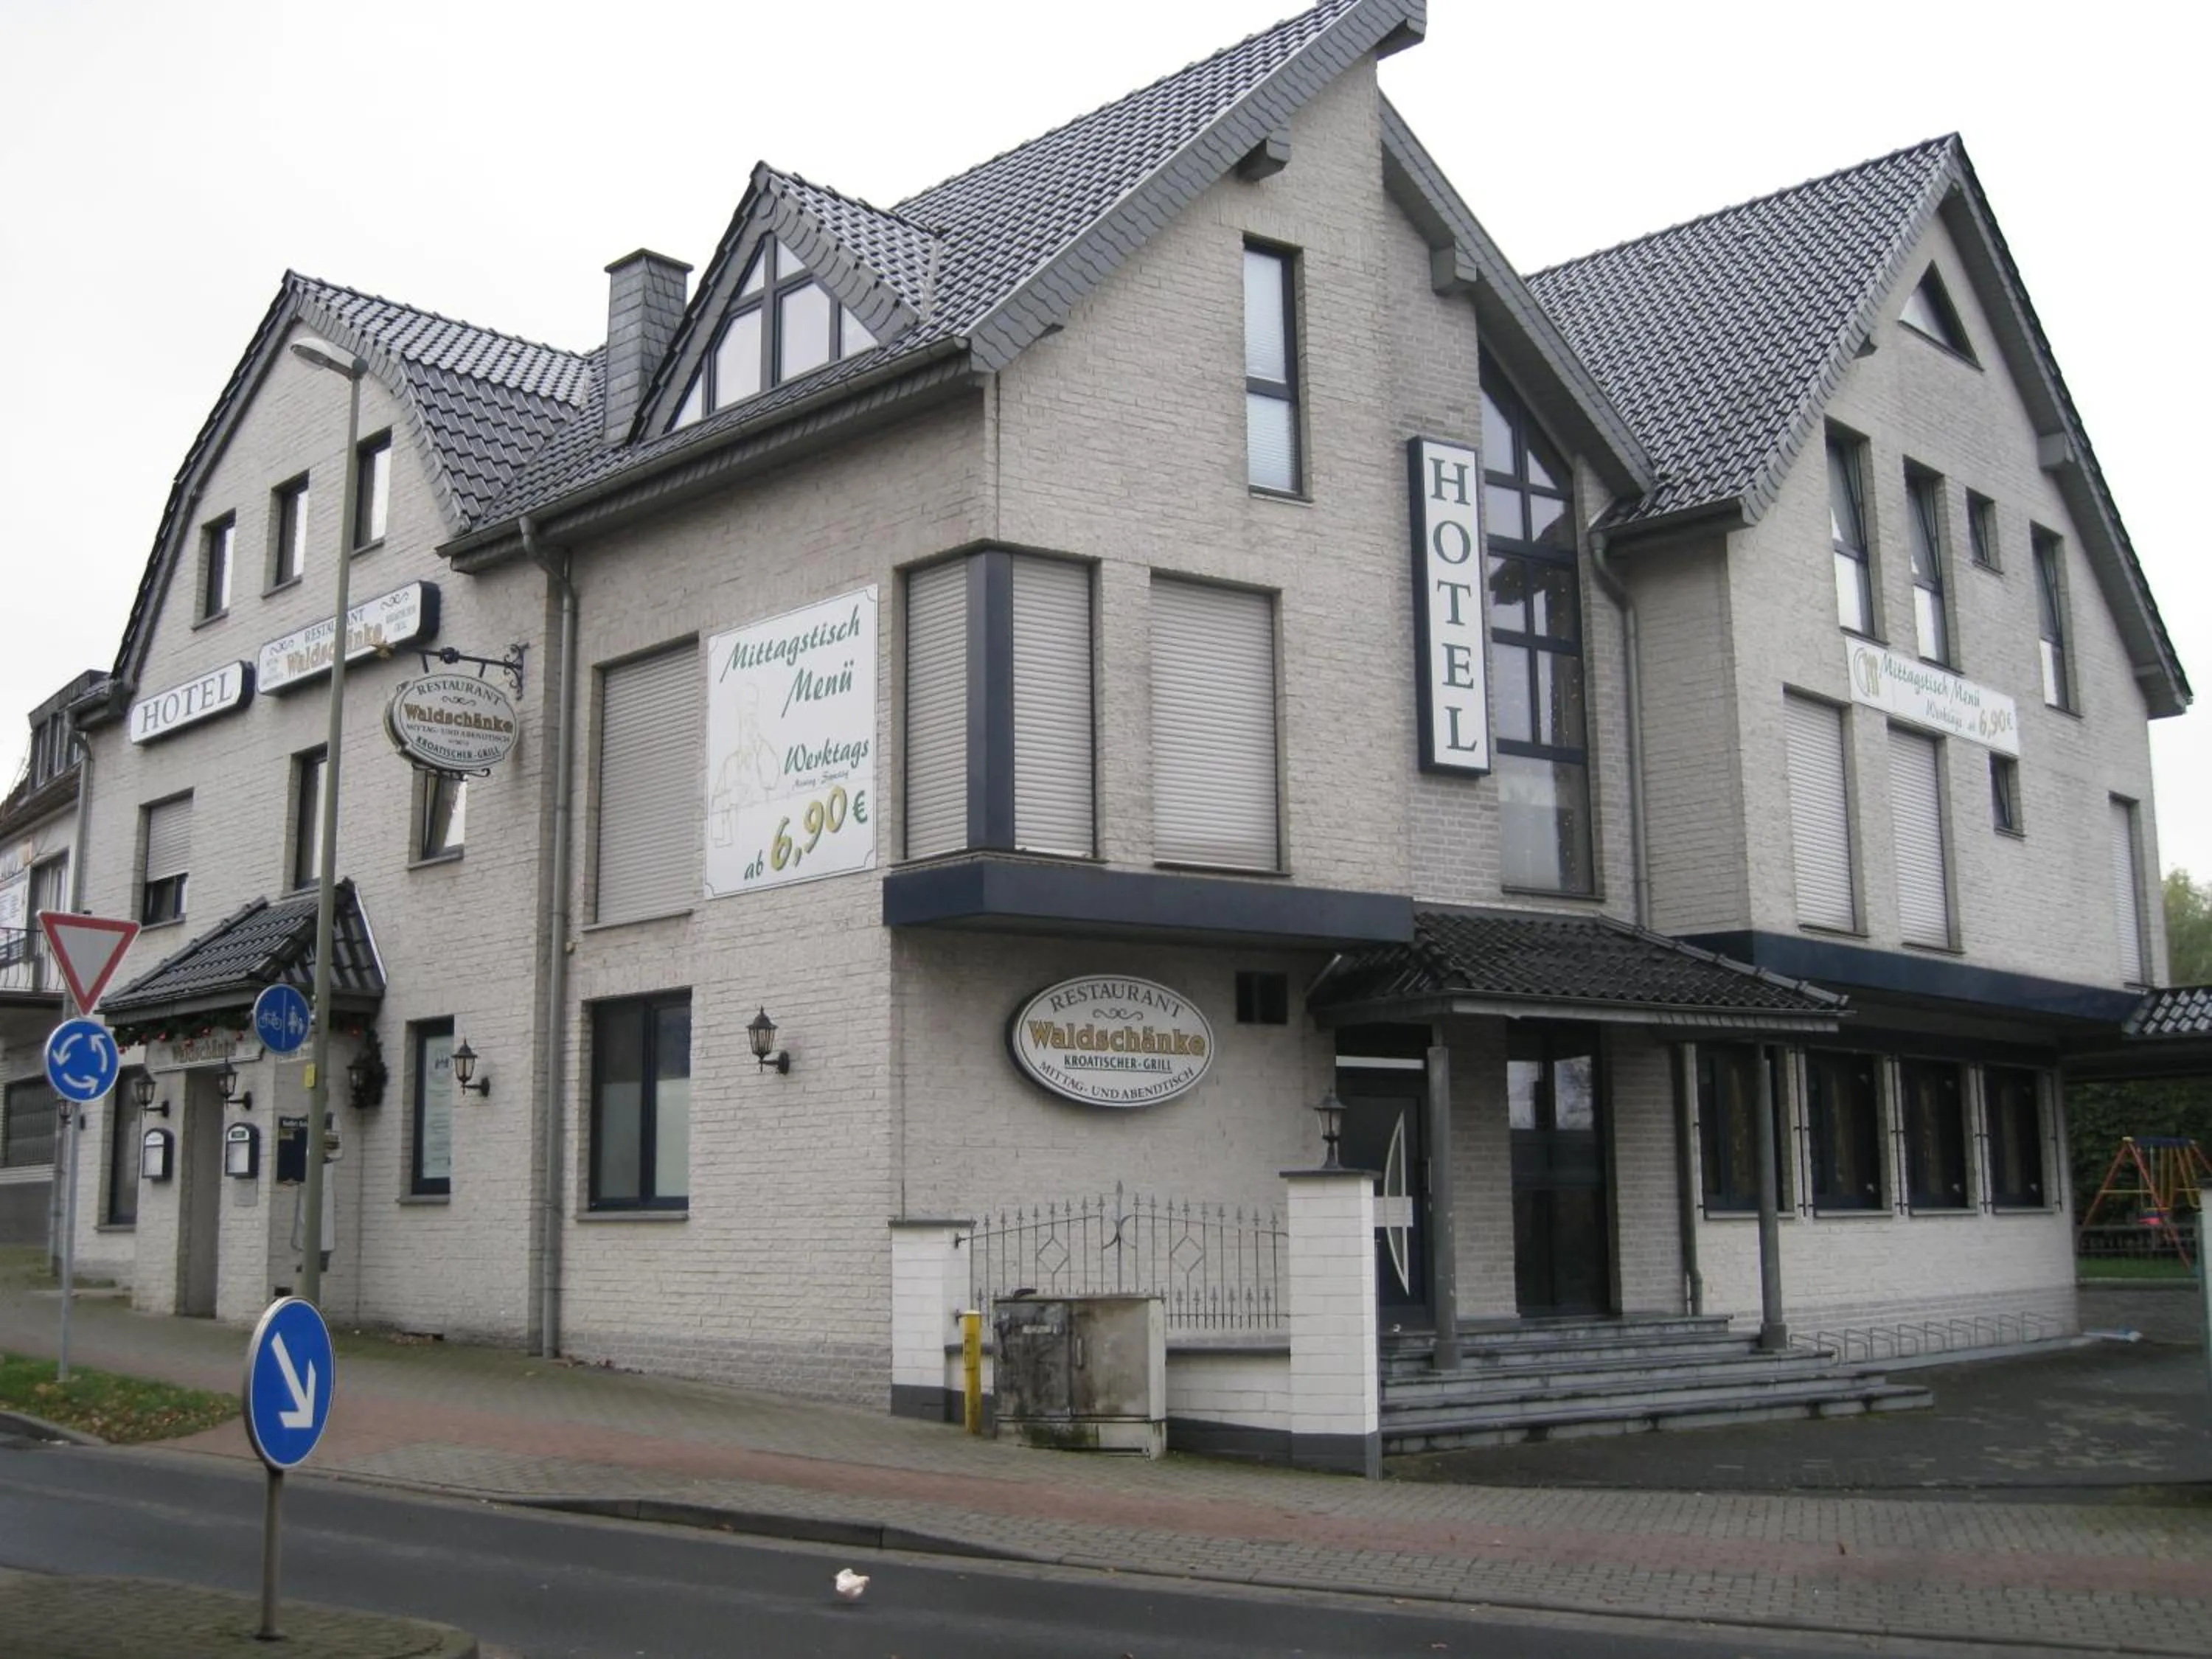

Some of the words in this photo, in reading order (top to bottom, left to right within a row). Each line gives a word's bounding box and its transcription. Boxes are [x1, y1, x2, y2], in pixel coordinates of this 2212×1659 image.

[1429, 456, 1478, 751] HOTEL
[720, 604, 860, 684] Mittagstisch
[417, 680, 503, 706] RESTAURANT
[781, 661, 855, 719] Menü
[1878, 652, 1949, 695] Mittagstisch
[1949, 679, 1980, 708] Menü
[141, 672, 233, 734] HOTEL
[404, 703, 514, 734] Waldschänke
[784, 738, 869, 776] Werktags
[744, 849, 764, 880] ab
[1048, 983, 1184, 1019] RESTAURANT
[1028, 1020, 1206, 1057] Waldschänke
[1091, 1087, 1119, 1099] UND
[1121, 1066, 1195, 1099] ABENDTISCH
